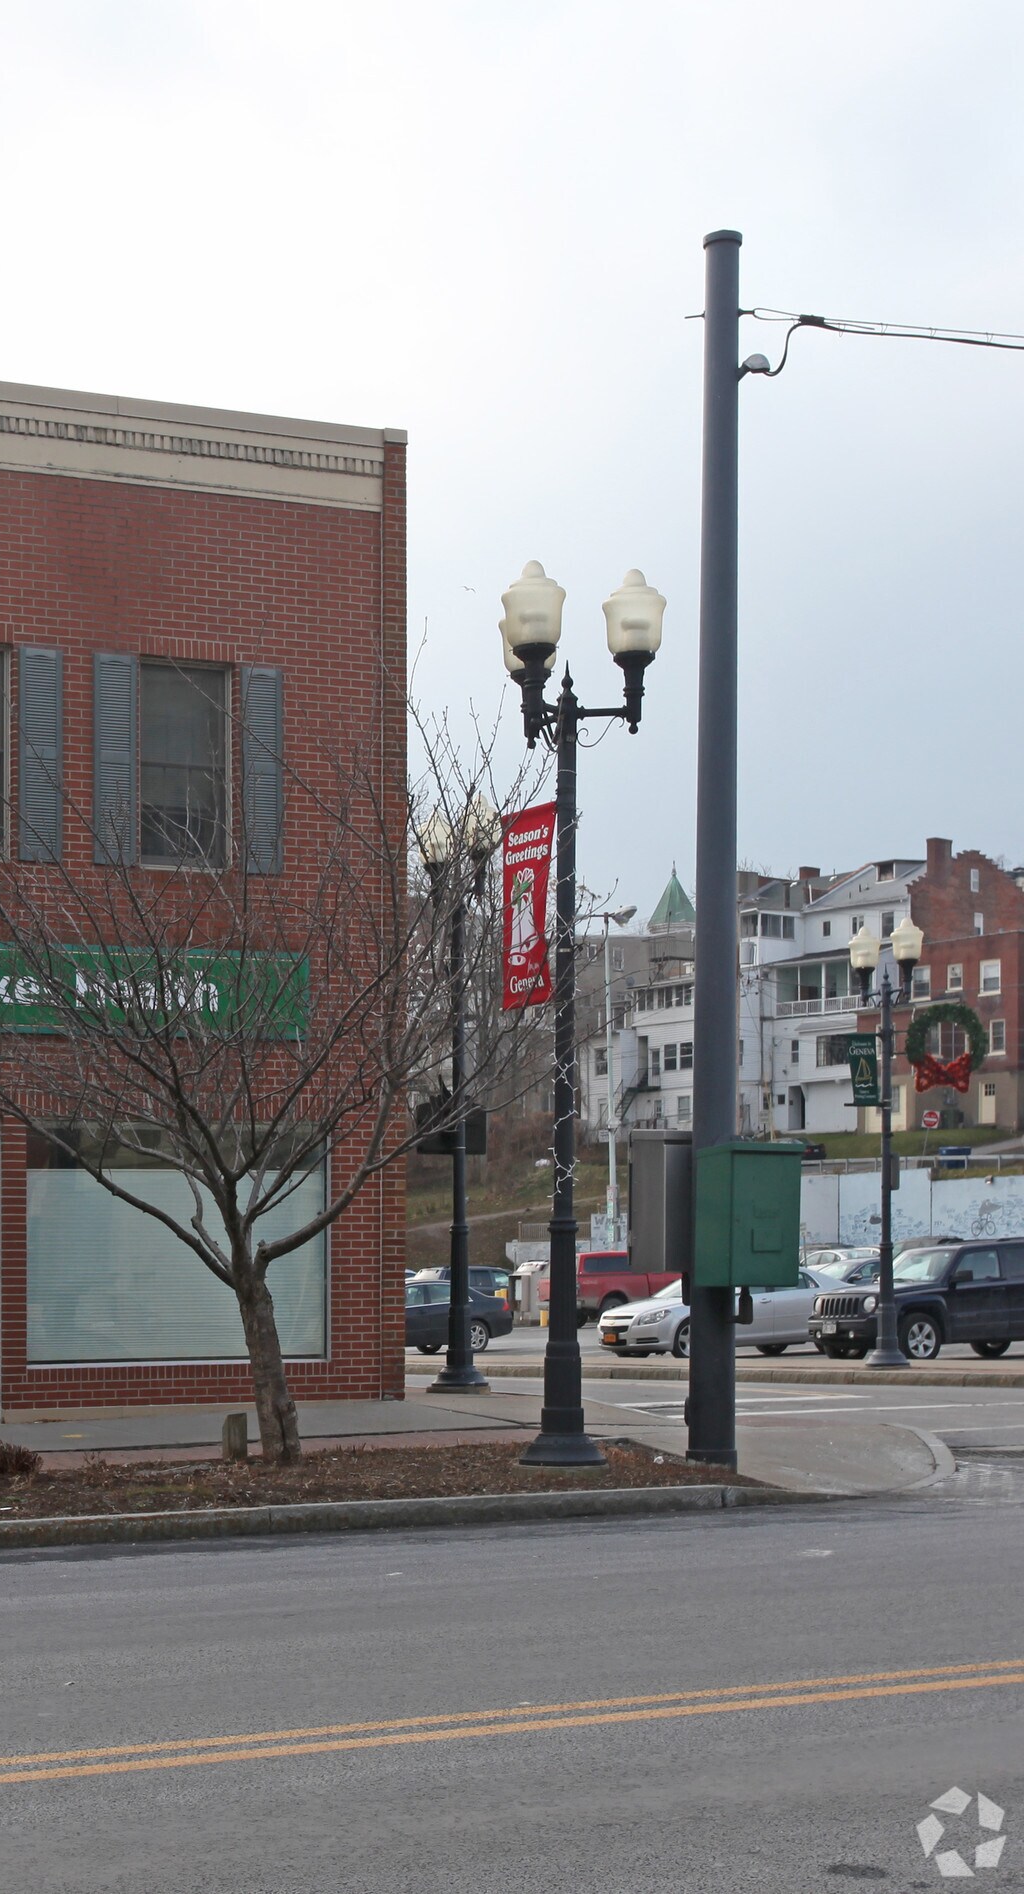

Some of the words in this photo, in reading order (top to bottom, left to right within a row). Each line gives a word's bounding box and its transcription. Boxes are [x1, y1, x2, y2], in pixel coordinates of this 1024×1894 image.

[508, 825, 549, 847] Season's
[505, 843, 549, 866] Greetings
[849, 1045, 875, 1056] GENEVA
